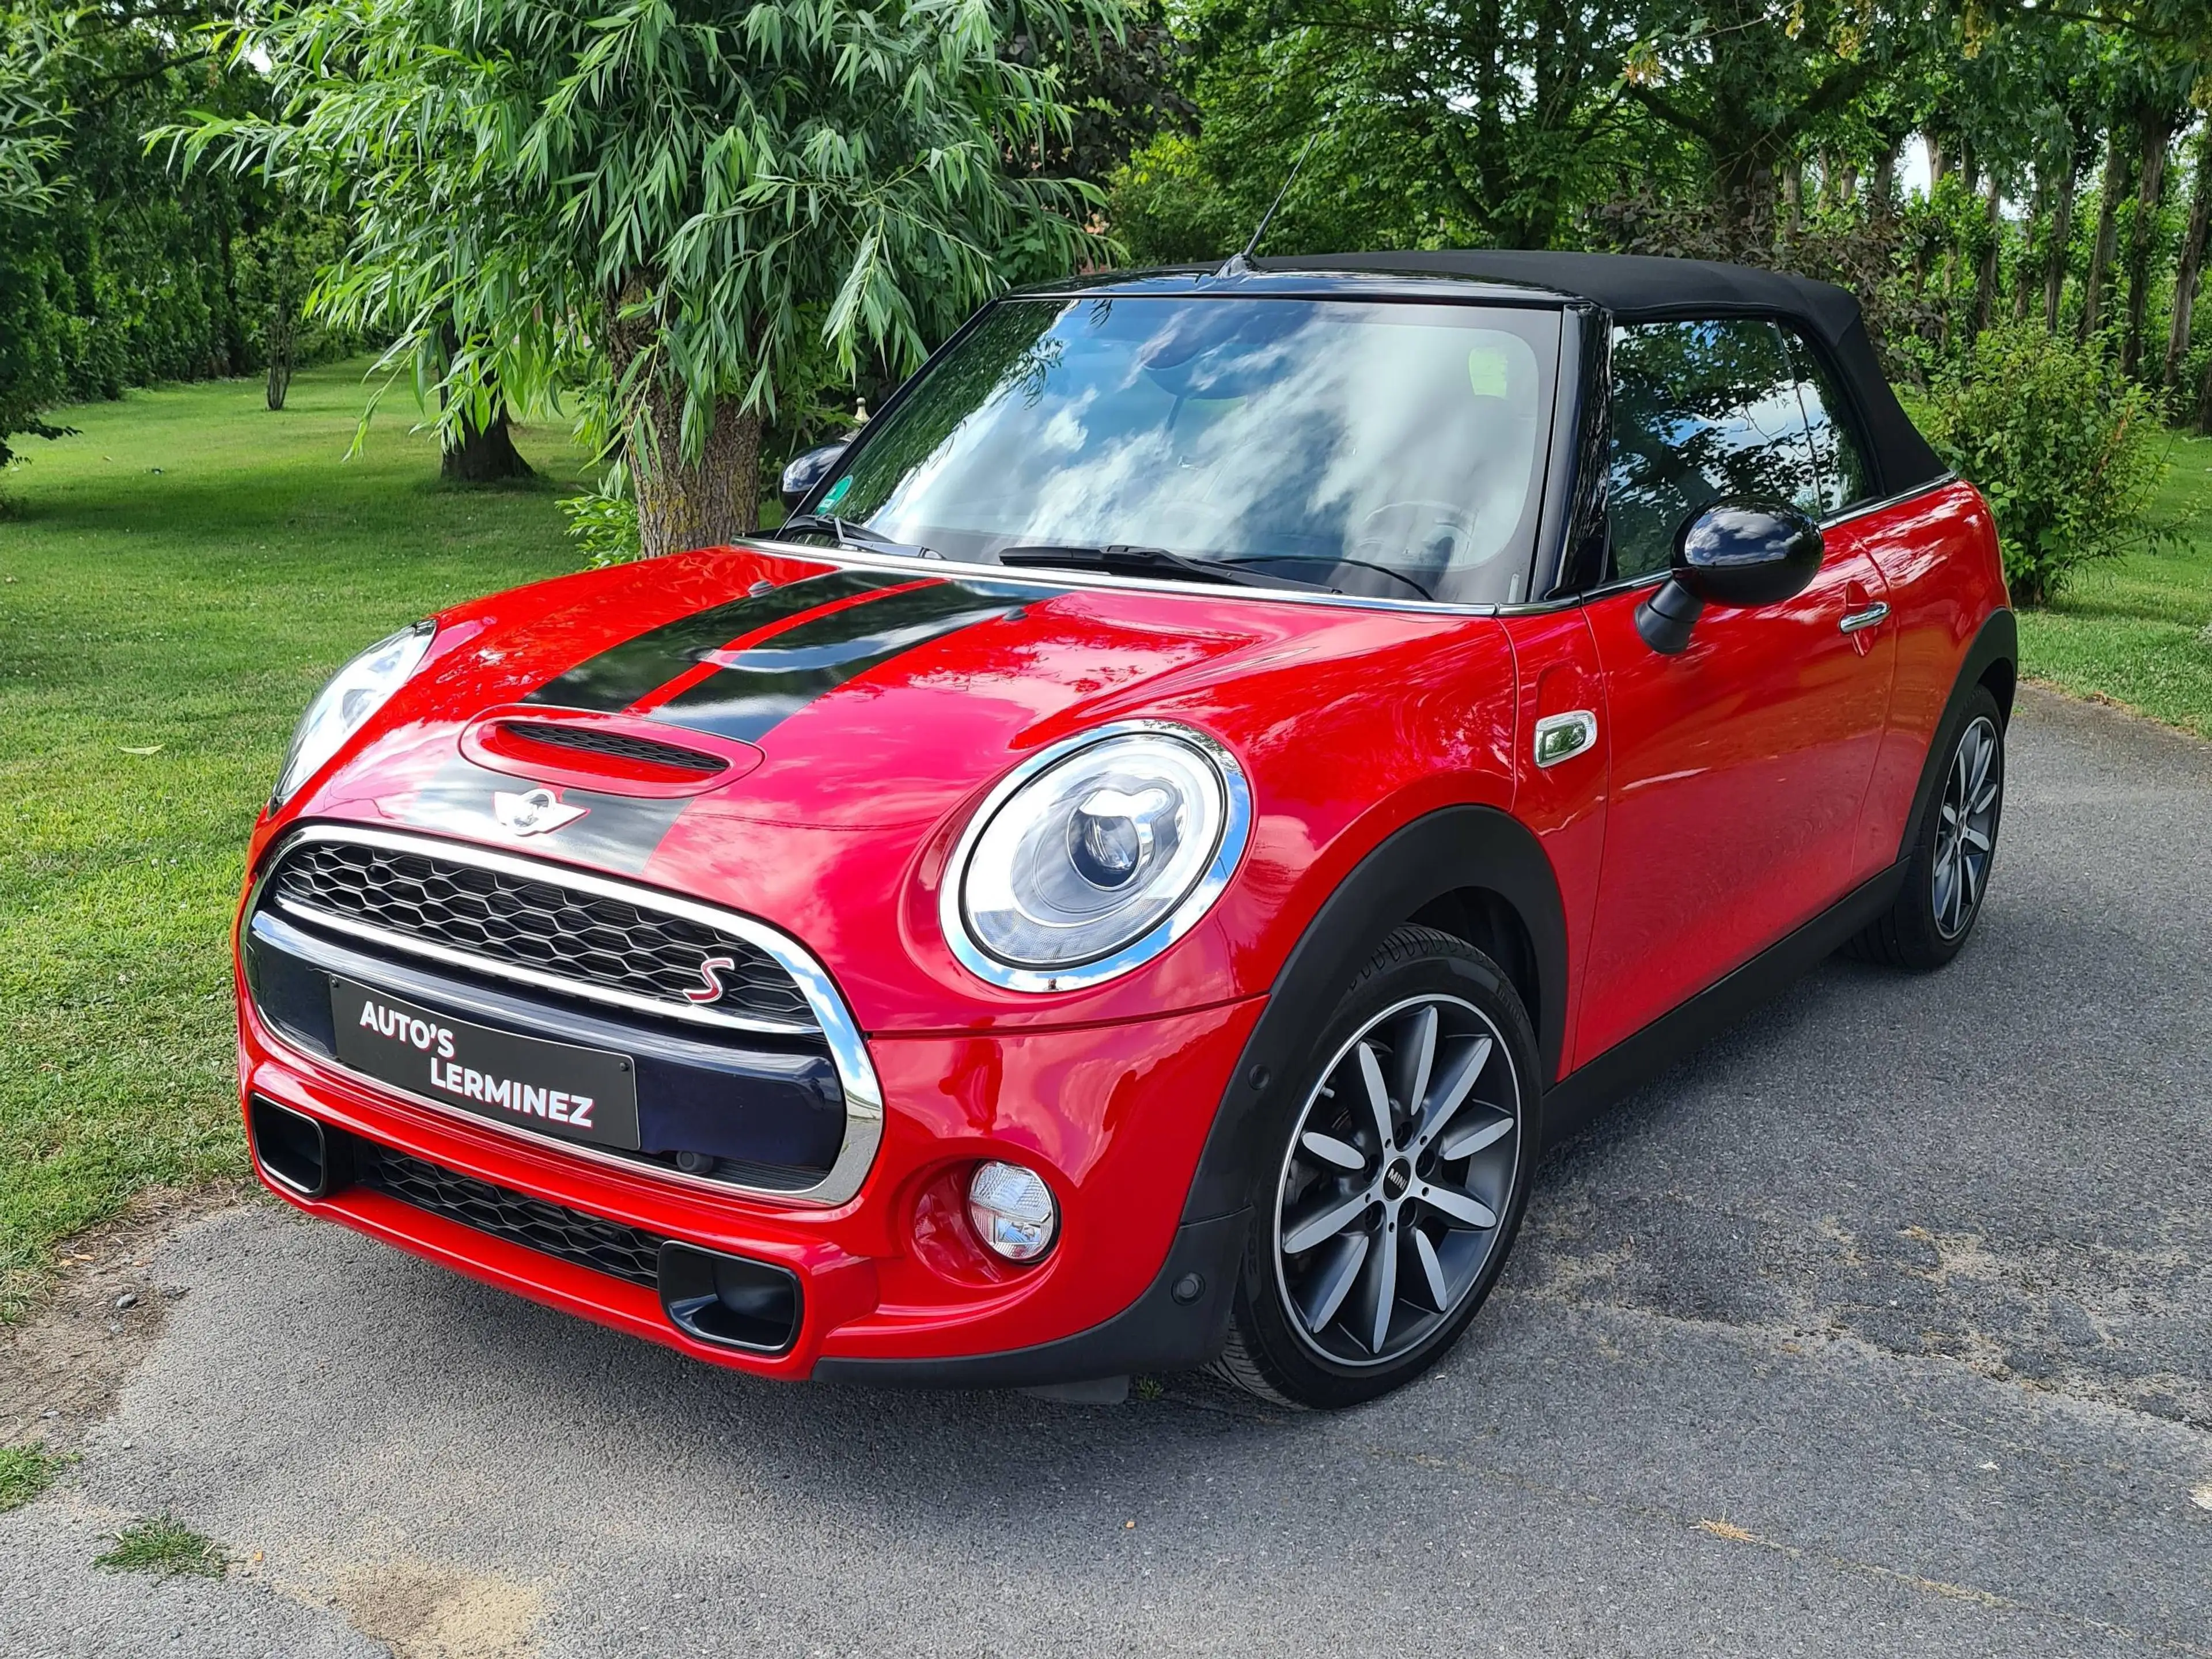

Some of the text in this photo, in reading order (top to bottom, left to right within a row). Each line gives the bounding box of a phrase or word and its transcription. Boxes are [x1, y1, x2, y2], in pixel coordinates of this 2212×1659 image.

[682, 957, 735, 1003] S
[359, 1001, 455, 1059] AUTO'S
[430, 1057, 594, 1128] LERMINEZ
[1388, 1168, 1407, 1191] MINI
